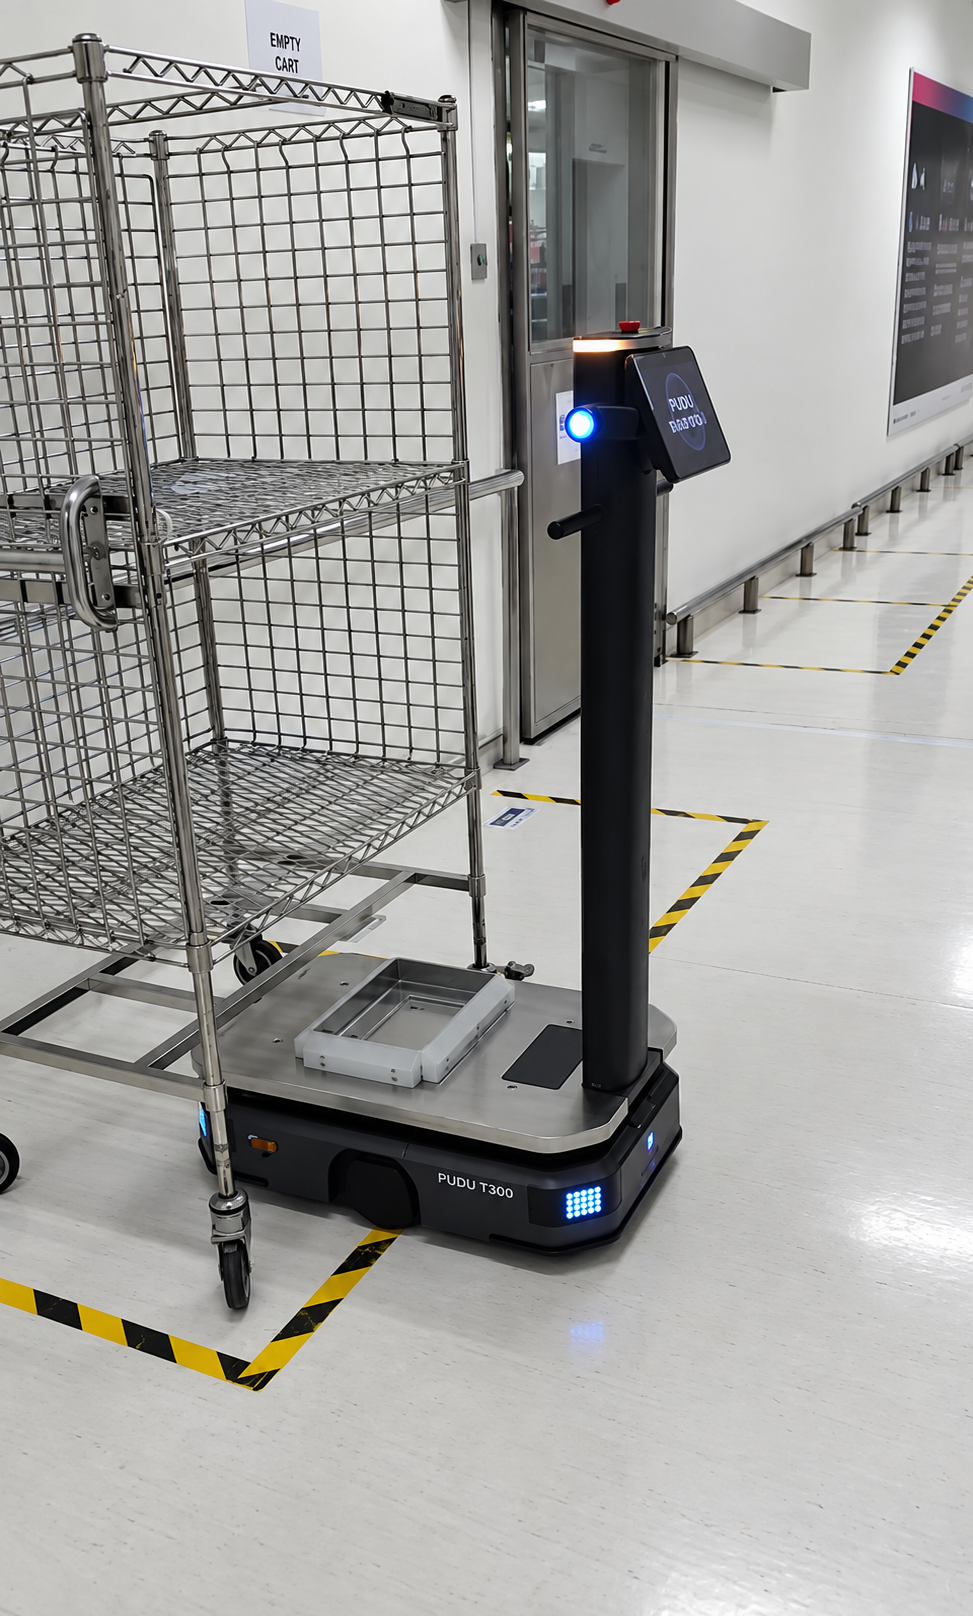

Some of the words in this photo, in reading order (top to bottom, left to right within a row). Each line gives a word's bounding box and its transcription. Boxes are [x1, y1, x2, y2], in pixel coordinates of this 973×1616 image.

[270, 32, 301, 52] EMPTY
[275, 56, 299, 74] CART
[668, 394, 694, 412] PUDU
[438, 1172, 476, 1190] PUDU
[479, 1182, 514, 1199] T300
